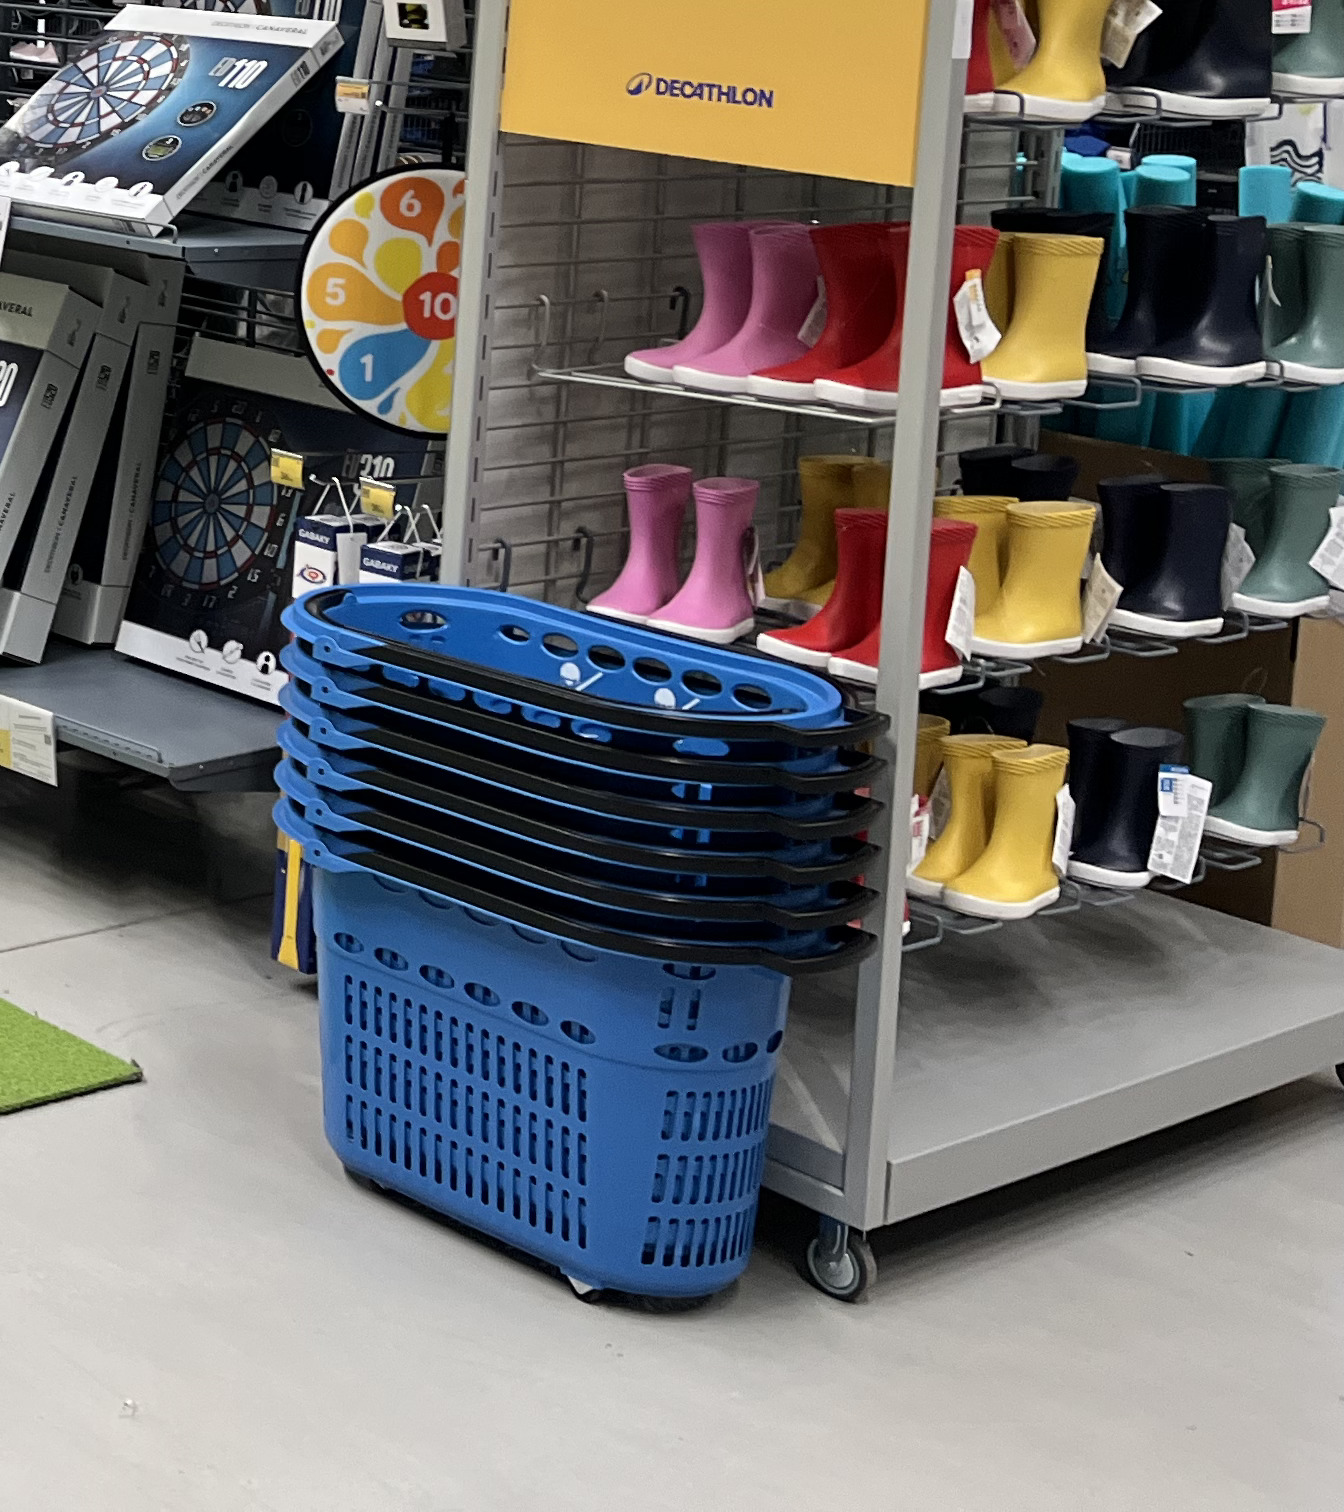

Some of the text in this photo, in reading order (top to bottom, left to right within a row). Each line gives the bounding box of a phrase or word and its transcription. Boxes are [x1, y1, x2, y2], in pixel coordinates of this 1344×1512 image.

[654, 76, 774, 108] DECATHLON
[399, 190, 422, 217] 6
[325, 278, 347, 305] 5
[418, 291, 457, 320] 10
[360, 354, 374, 382] 1
